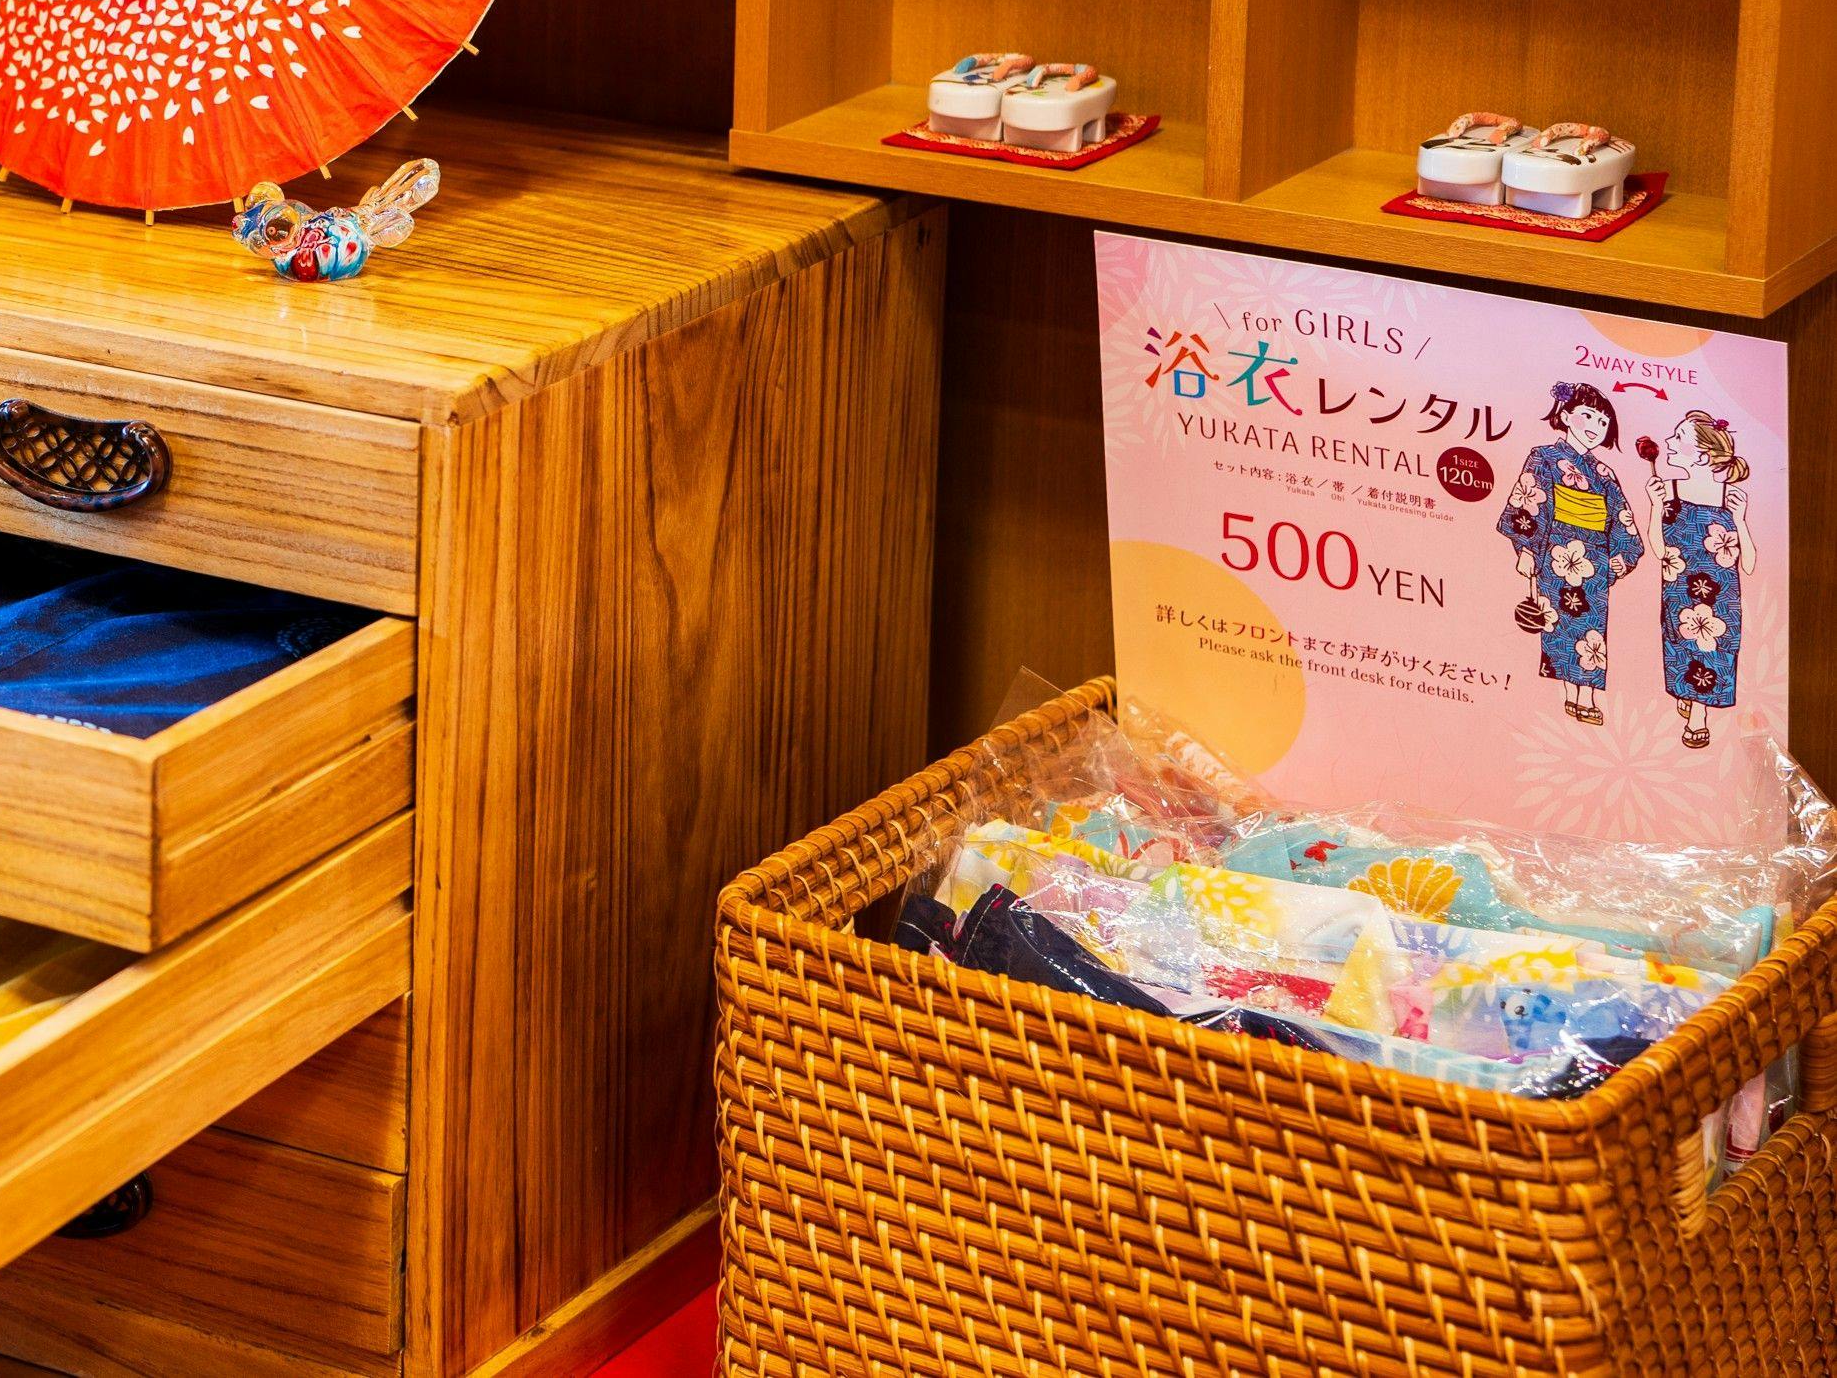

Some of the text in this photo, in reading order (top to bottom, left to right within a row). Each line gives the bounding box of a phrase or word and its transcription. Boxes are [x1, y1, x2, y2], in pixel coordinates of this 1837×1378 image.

[1241, 308, 1405, 355] for GIRLS
[1143, 326, 1514, 442] 浴衣レンタル
[1575, 345, 1698, 385] 2WAY STYLE
[1177, 412, 1430, 478] YUKATA RENTAL
[1439, 466, 1493, 491] 120cm
[1285, 485, 1455, 522] Yukata Obi Yukata Dressing Guide
[1198, 637, 1475, 704] Please ask the front desk for details.
